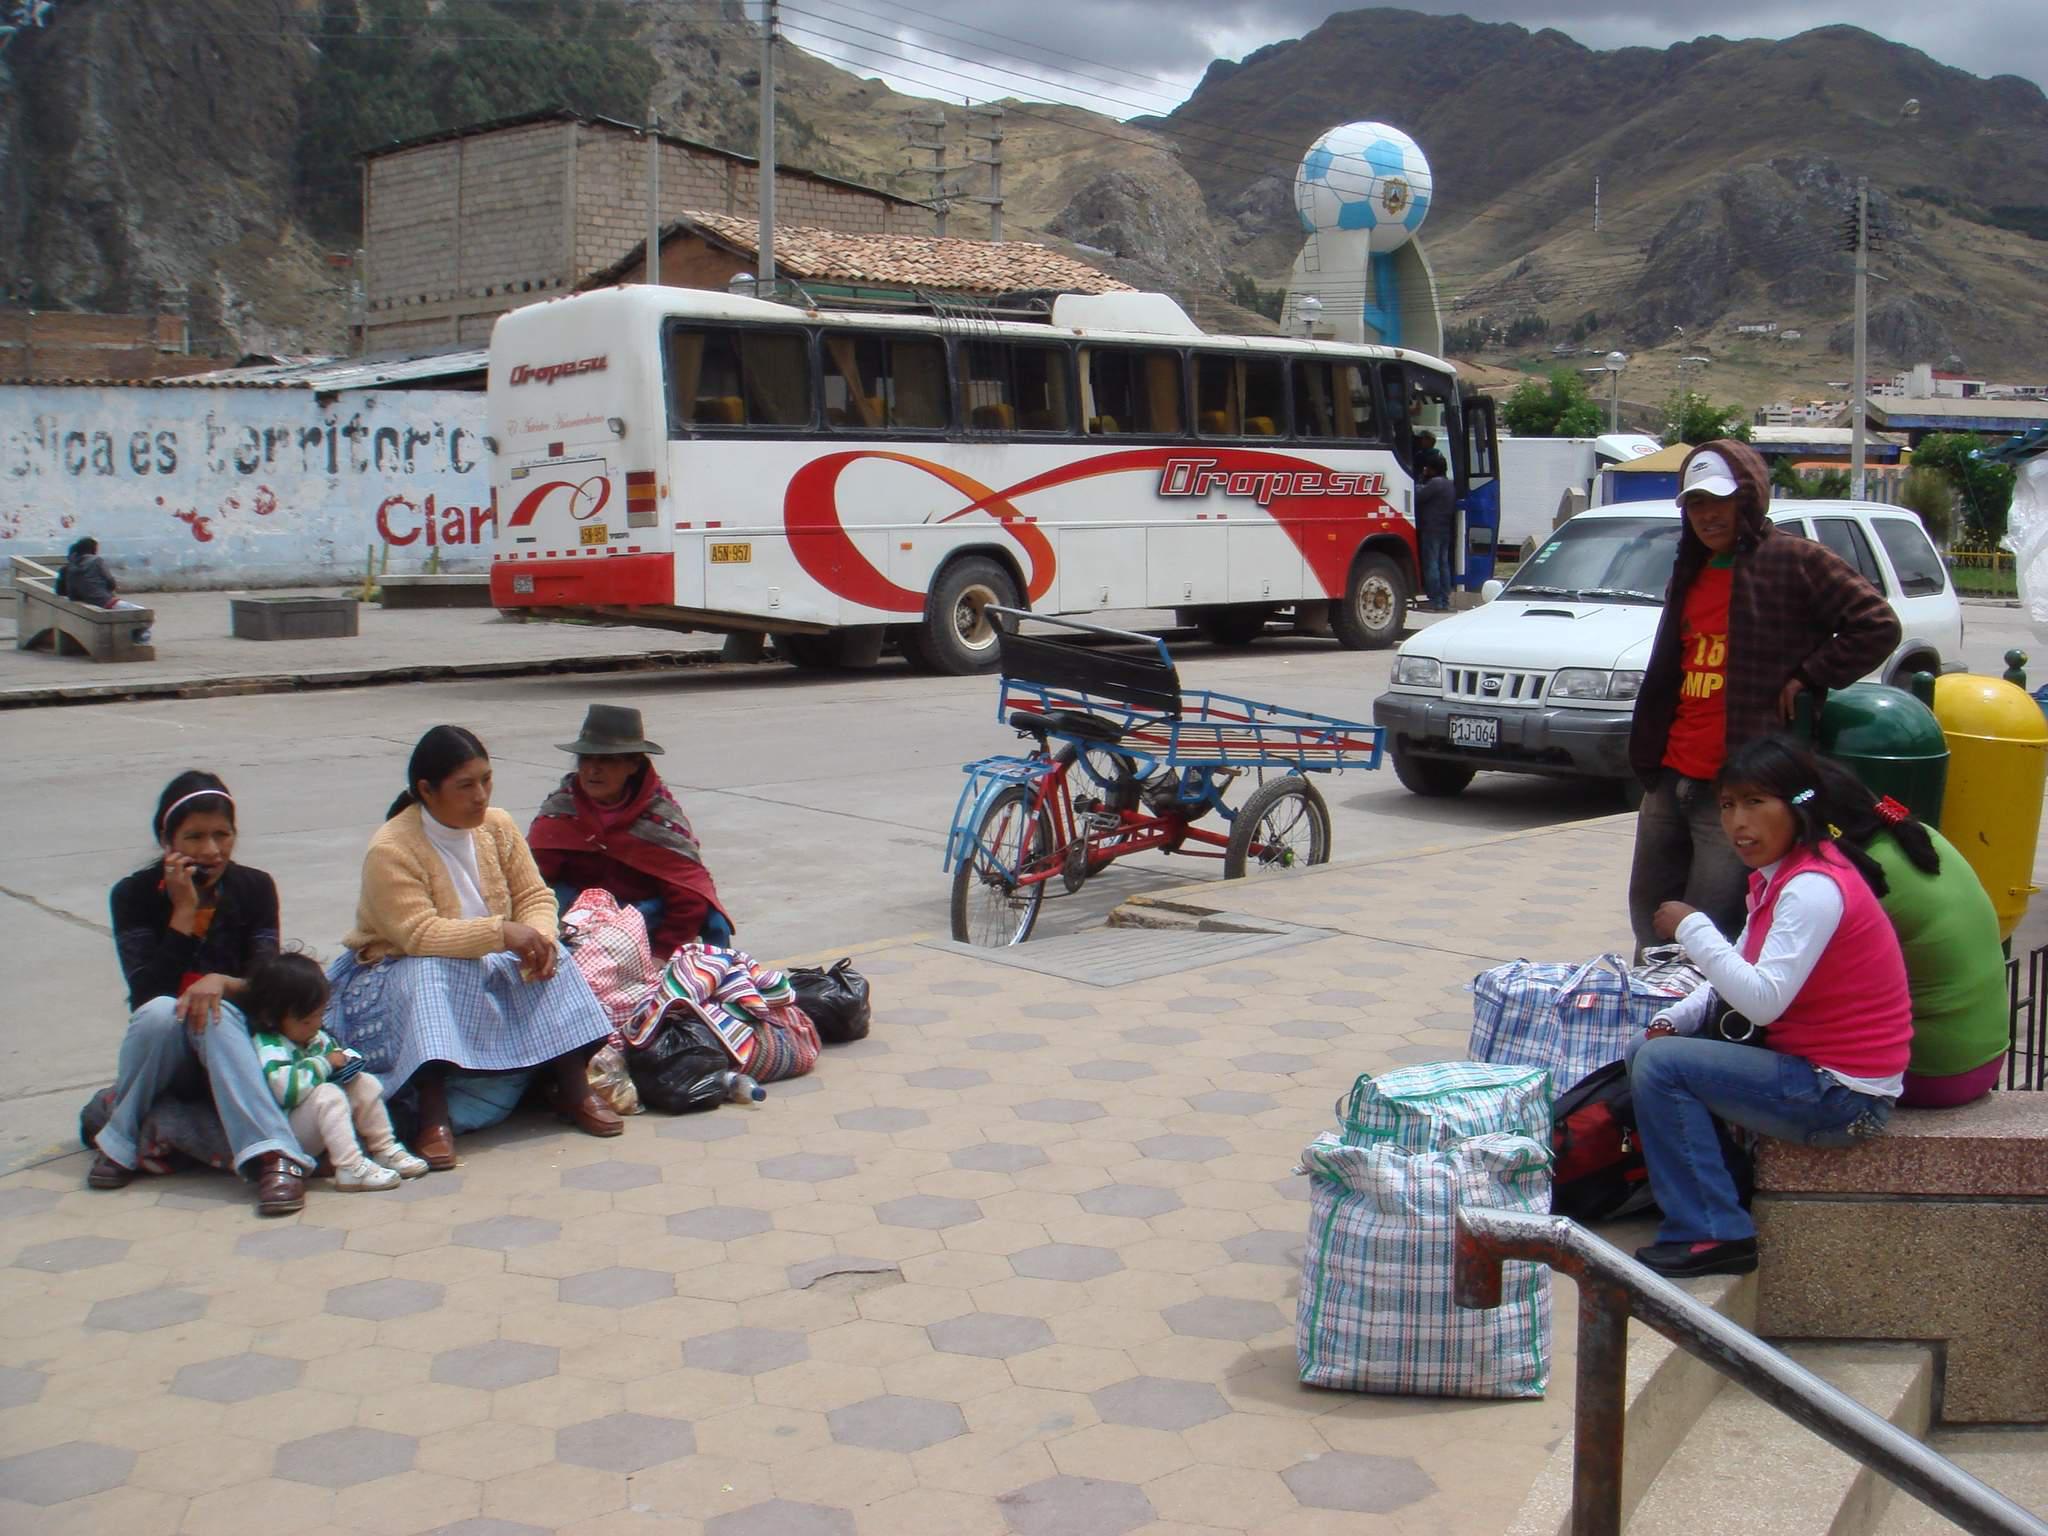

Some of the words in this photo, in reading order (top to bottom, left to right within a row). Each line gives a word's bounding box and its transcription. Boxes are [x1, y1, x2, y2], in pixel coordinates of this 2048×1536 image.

[510, 356, 608, 386] Oropesa
[129, 431, 178, 475] es
[1158, 458, 1389, 505] Oropesa
[711, 545, 750, 561] A5N-957
[1693, 632, 1727, 667] 15
[1451, 721, 1496, 743] P1J-064
